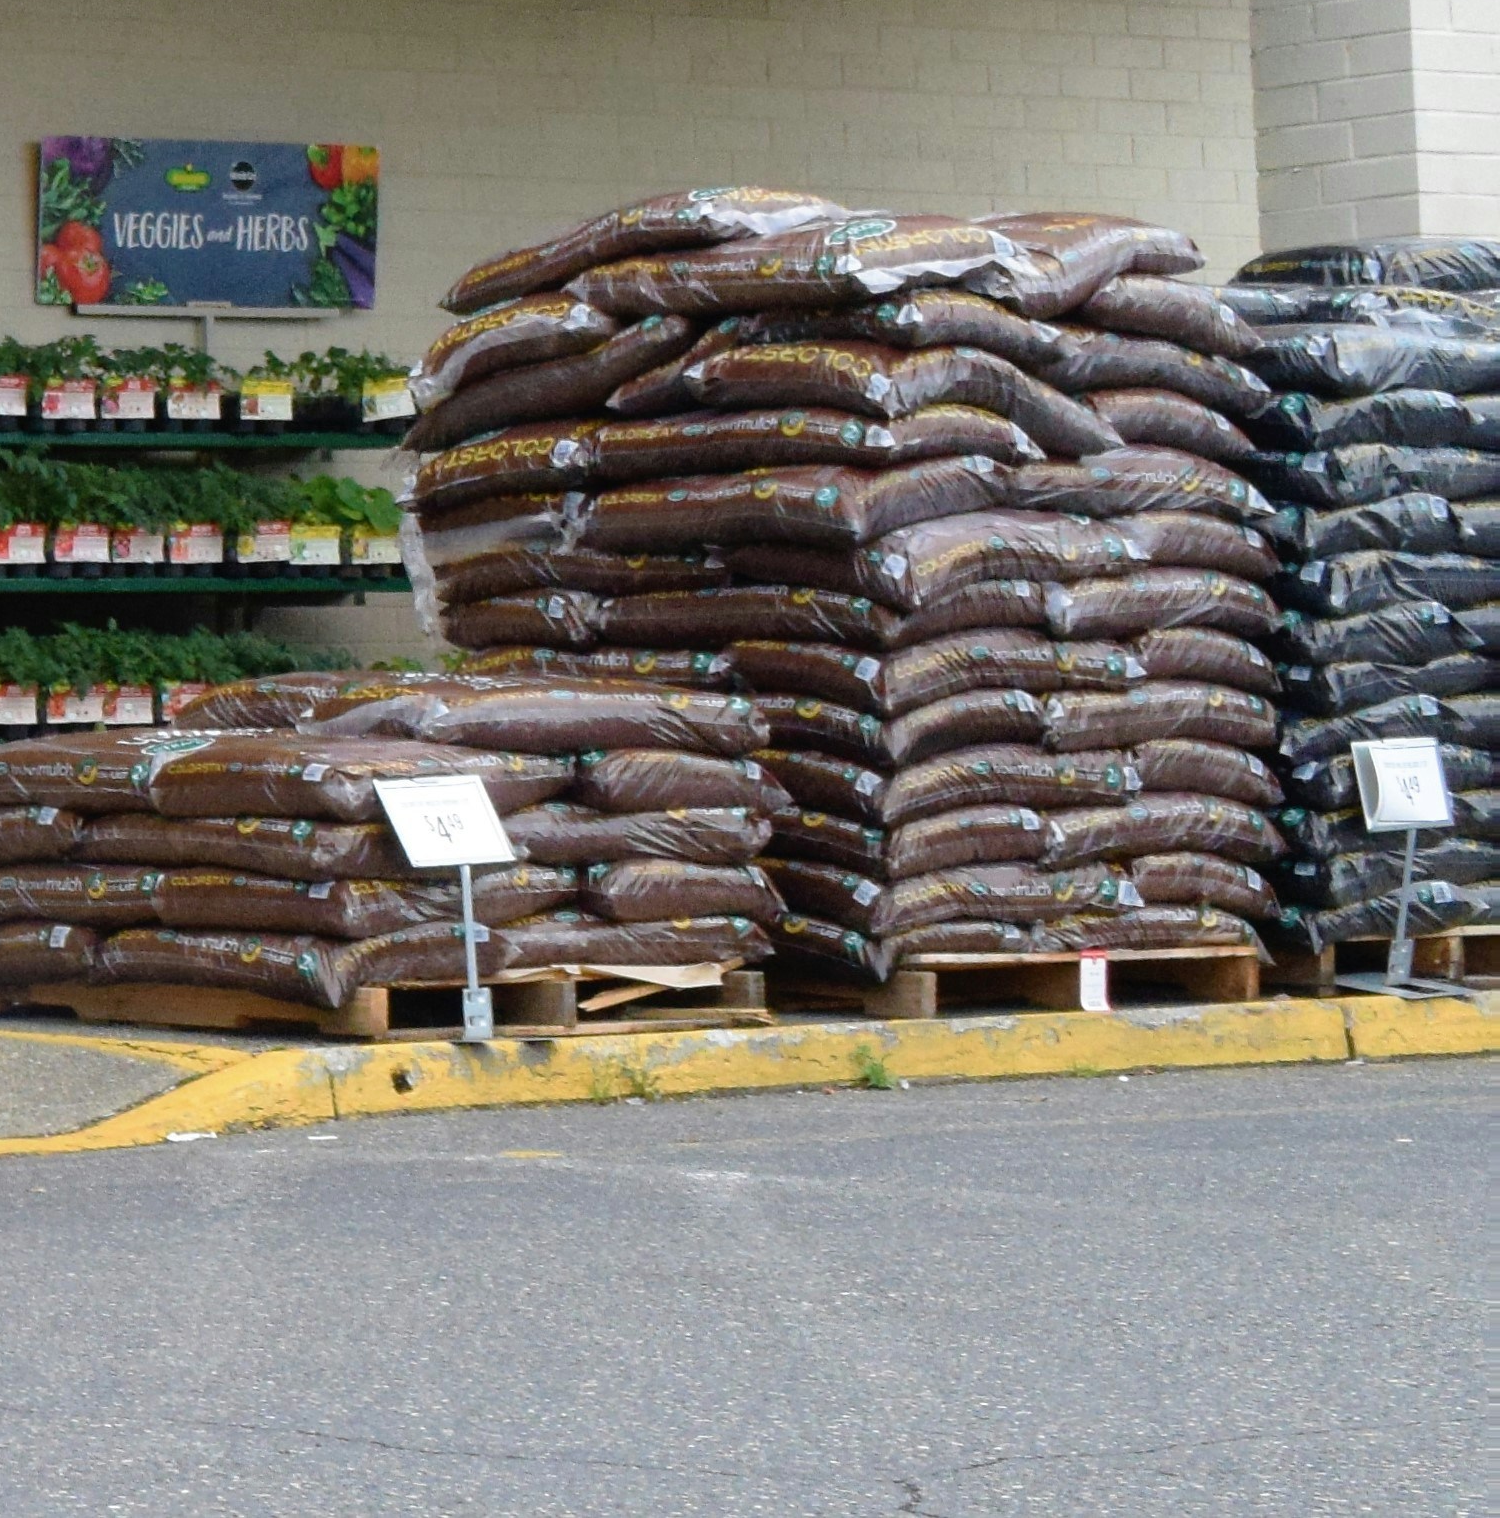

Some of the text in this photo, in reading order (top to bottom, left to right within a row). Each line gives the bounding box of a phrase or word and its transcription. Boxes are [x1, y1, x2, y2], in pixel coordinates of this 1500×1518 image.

[114, 211, 310, 252] VEGGIES and HERBS
